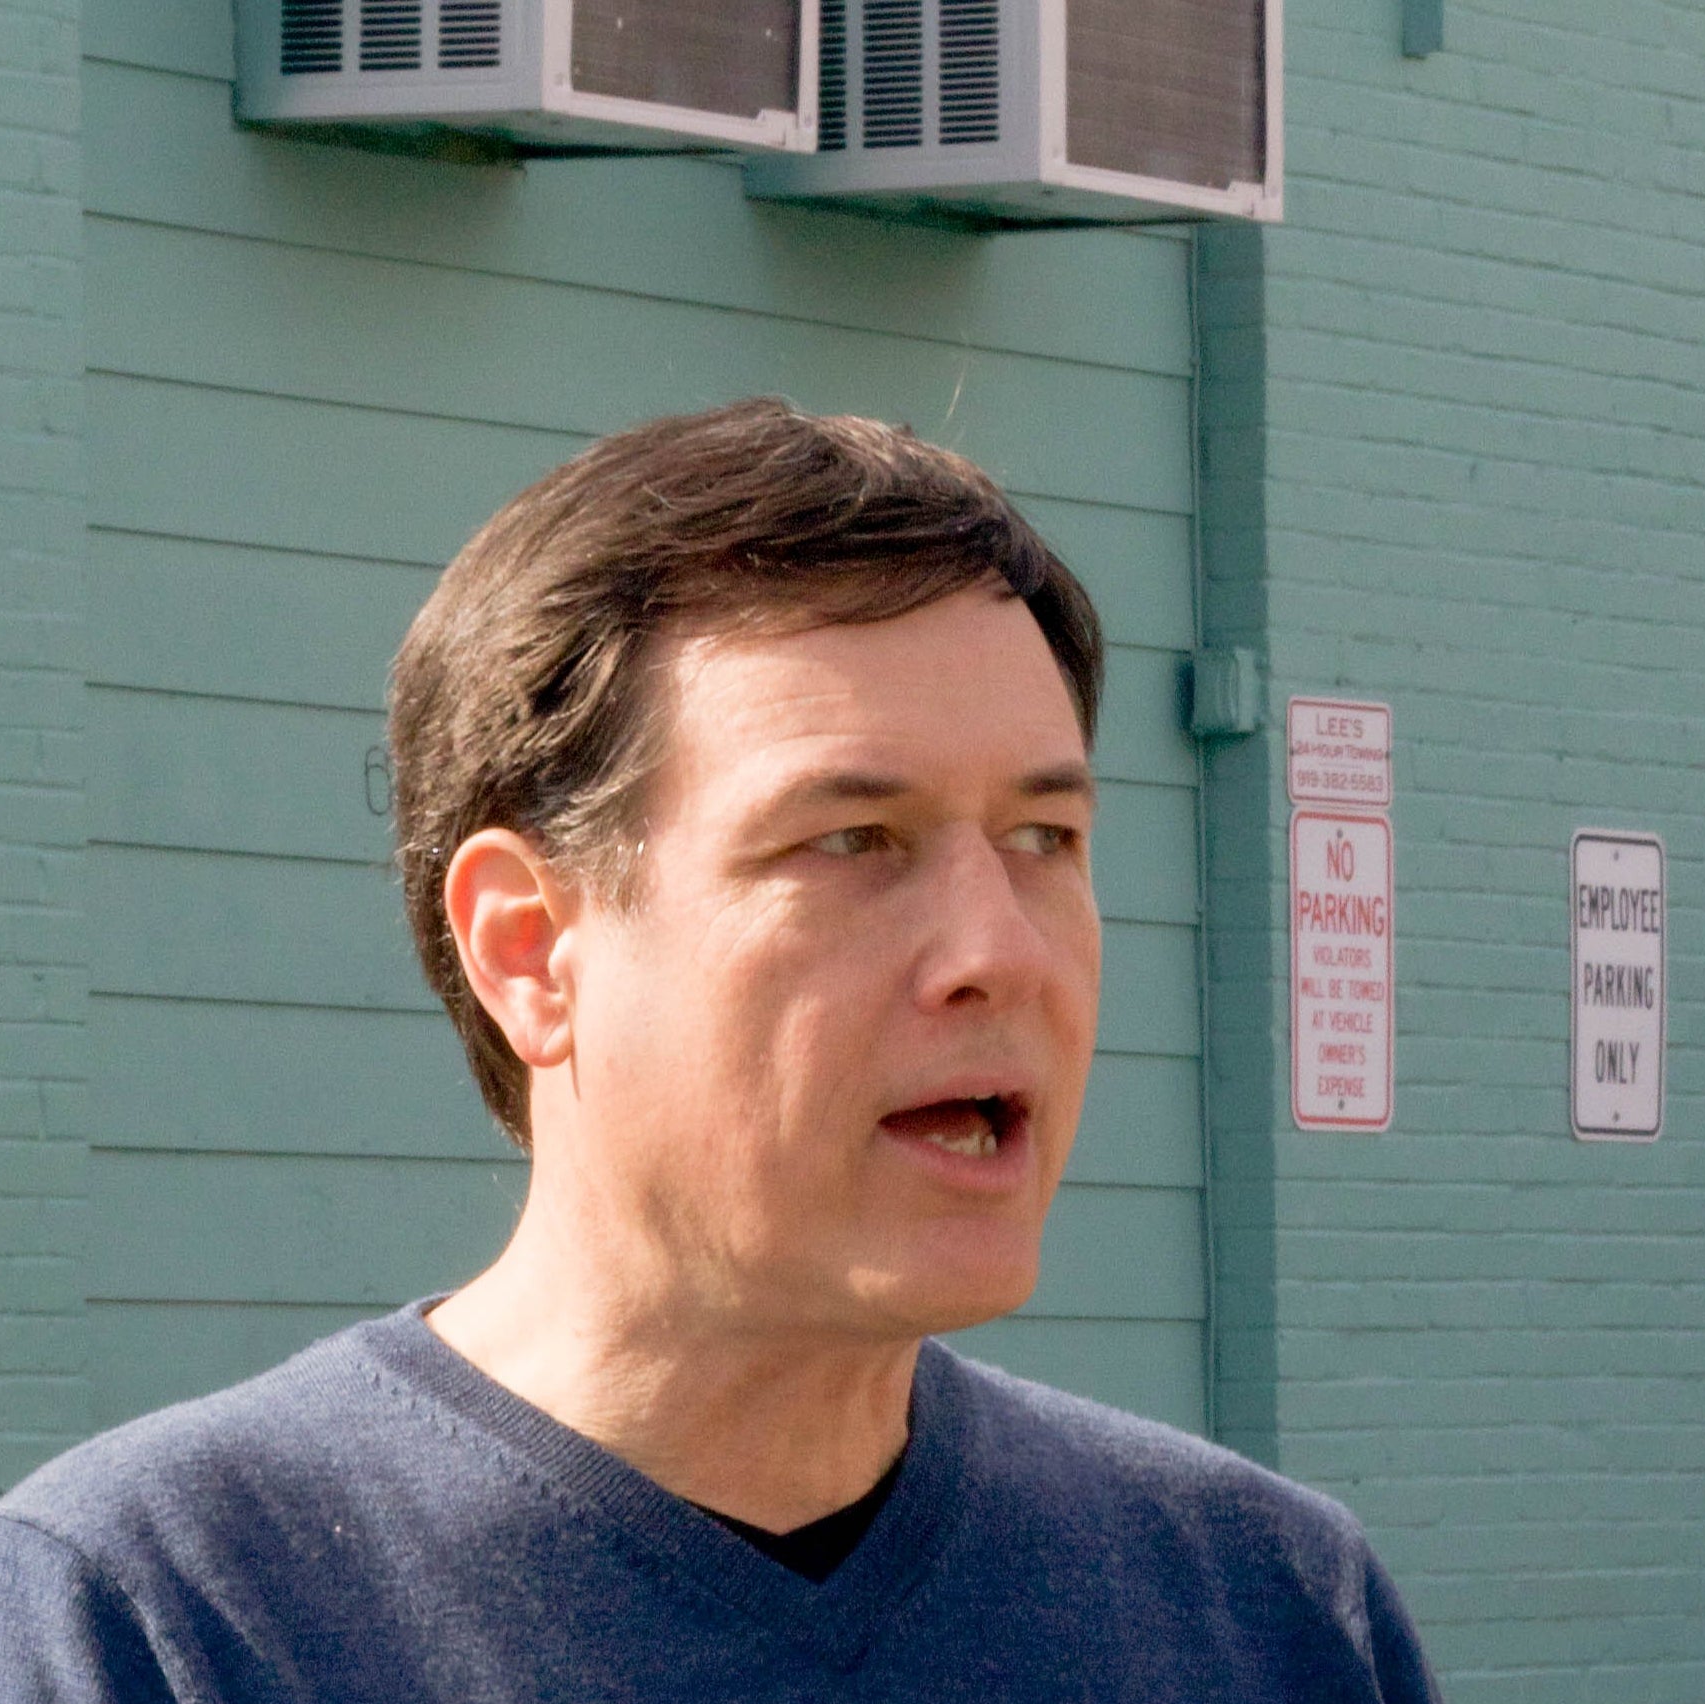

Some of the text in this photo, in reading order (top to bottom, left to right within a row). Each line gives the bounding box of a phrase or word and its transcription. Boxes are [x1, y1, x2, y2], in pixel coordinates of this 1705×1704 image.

[1316, 712, 1364, 738] LEE'S
[1326, 840, 1355, 882] NO
[1299, 891, 1385, 938] PARKING
[1578, 884, 1661, 934] EMPLOYEE
[1312, 946, 1372, 969] VIOLATORS
[1300, 977, 1385, 1001] WILL BE TOWED
[1583, 962, 1654, 1011] PARKING
[1312, 1010, 1373, 1034] AT VEHICLE
[1318, 1044, 1366, 1066] OWNER'S
[1594, 1039, 1640, 1085] ONLY
[1317, 1076, 1365, 1098] EXPENSE
